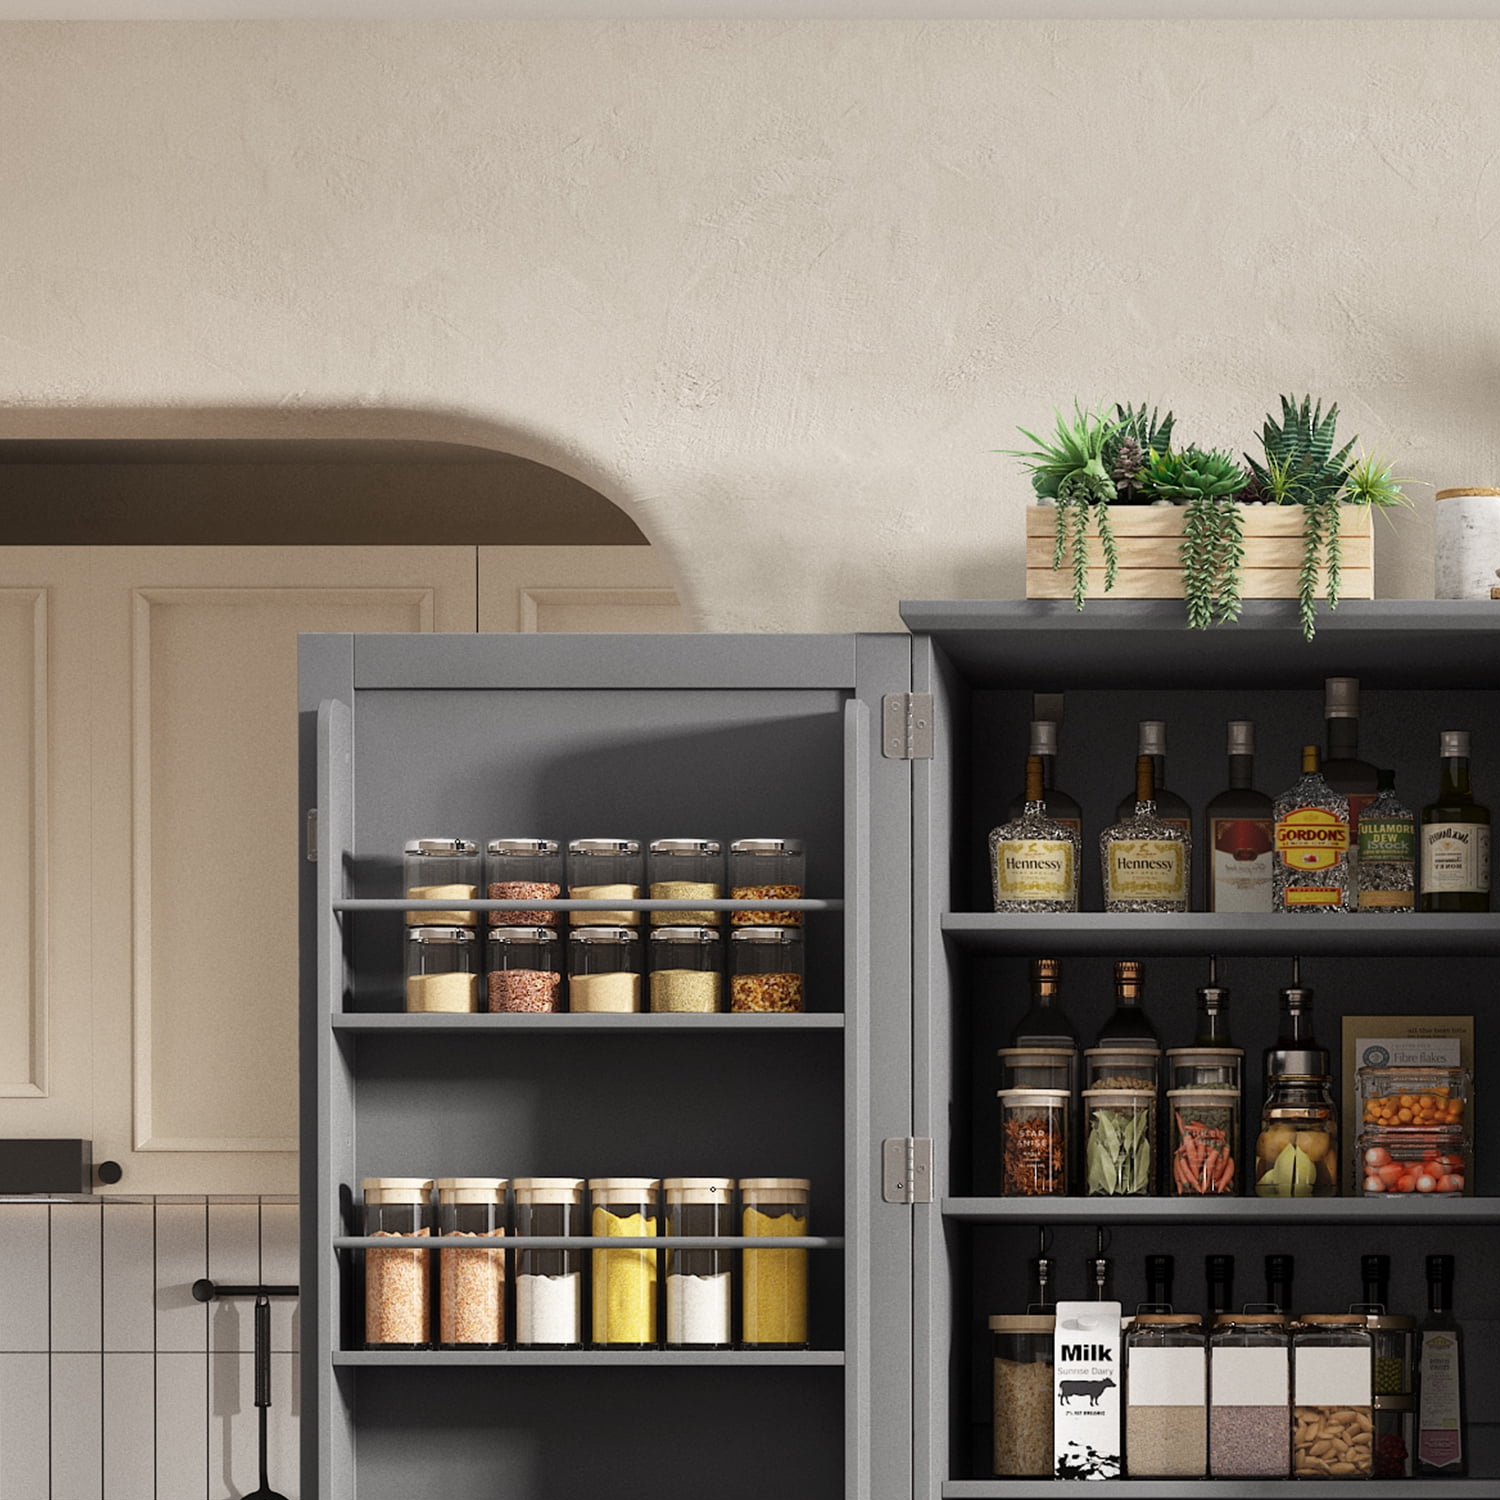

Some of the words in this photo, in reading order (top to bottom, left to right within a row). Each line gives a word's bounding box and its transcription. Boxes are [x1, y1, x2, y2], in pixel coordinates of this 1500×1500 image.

[1277, 828, 1346, 842] GORDON'S
[1373, 834, 1398, 843] DEW
[1006, 857, 1062, 871] Hennessy
[1117, 857, 1174, 871] Hennessy
[1394, 1052, 1418, 1063] Fibre
[1420, 1052, 1447, 1063] flakes
[1061, 1344, 1113, 1362] Milk
[1058, 1367, 1089, 1375] Sunrise
[1091, 1367, 1114, 1376] Dairy
